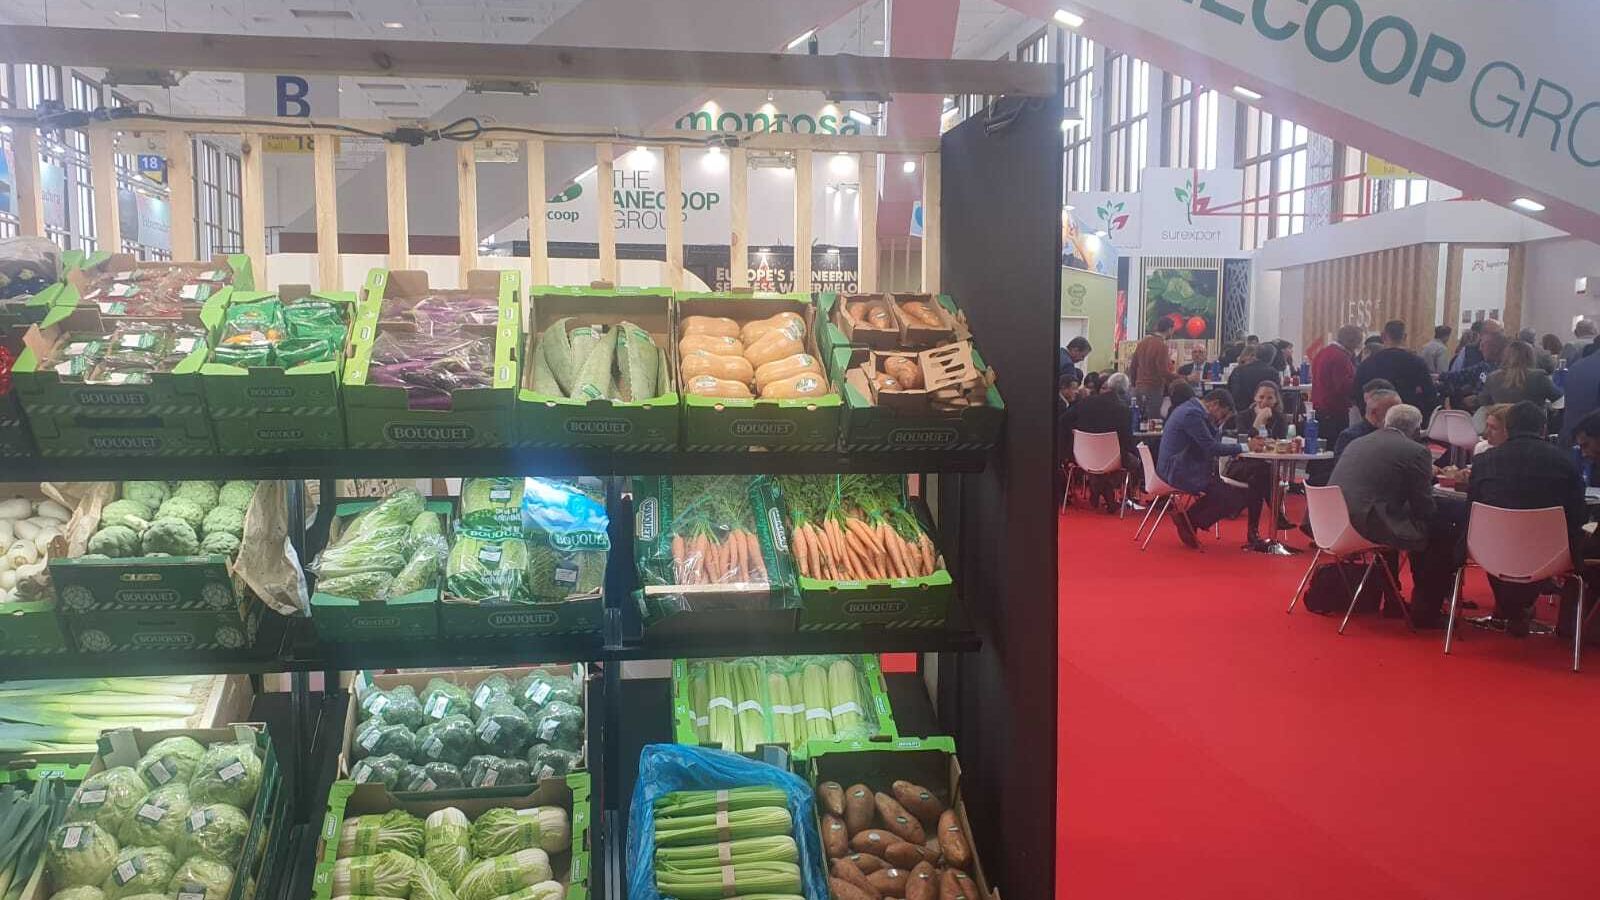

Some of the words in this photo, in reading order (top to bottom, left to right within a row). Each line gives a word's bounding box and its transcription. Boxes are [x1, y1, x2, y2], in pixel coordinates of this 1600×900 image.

[1178, 0, 1467, 98] COOP
[275, 75, 311, 117] B
[141, 156, 158, 169] 18
[1161, 230, 1221, 243] surexport
[716, 267, 786, 282] EUOPE'S
[80, 393, 146, 404] BOUQUET
[570, 421, 627, 432] BOUQUET
[735, 423, 792, 434] BOUQUET
[393, 427, 472, 439] BOUQUET
[895, 432, 952, 443] BOUQUET
[93, 437, 158, 448] BOUQUET
[122, 593, 174, 602] BOUQUET
[850, 602, 902, 612] BOUQUET
[496, 614, 553, 624] BOUQUET
